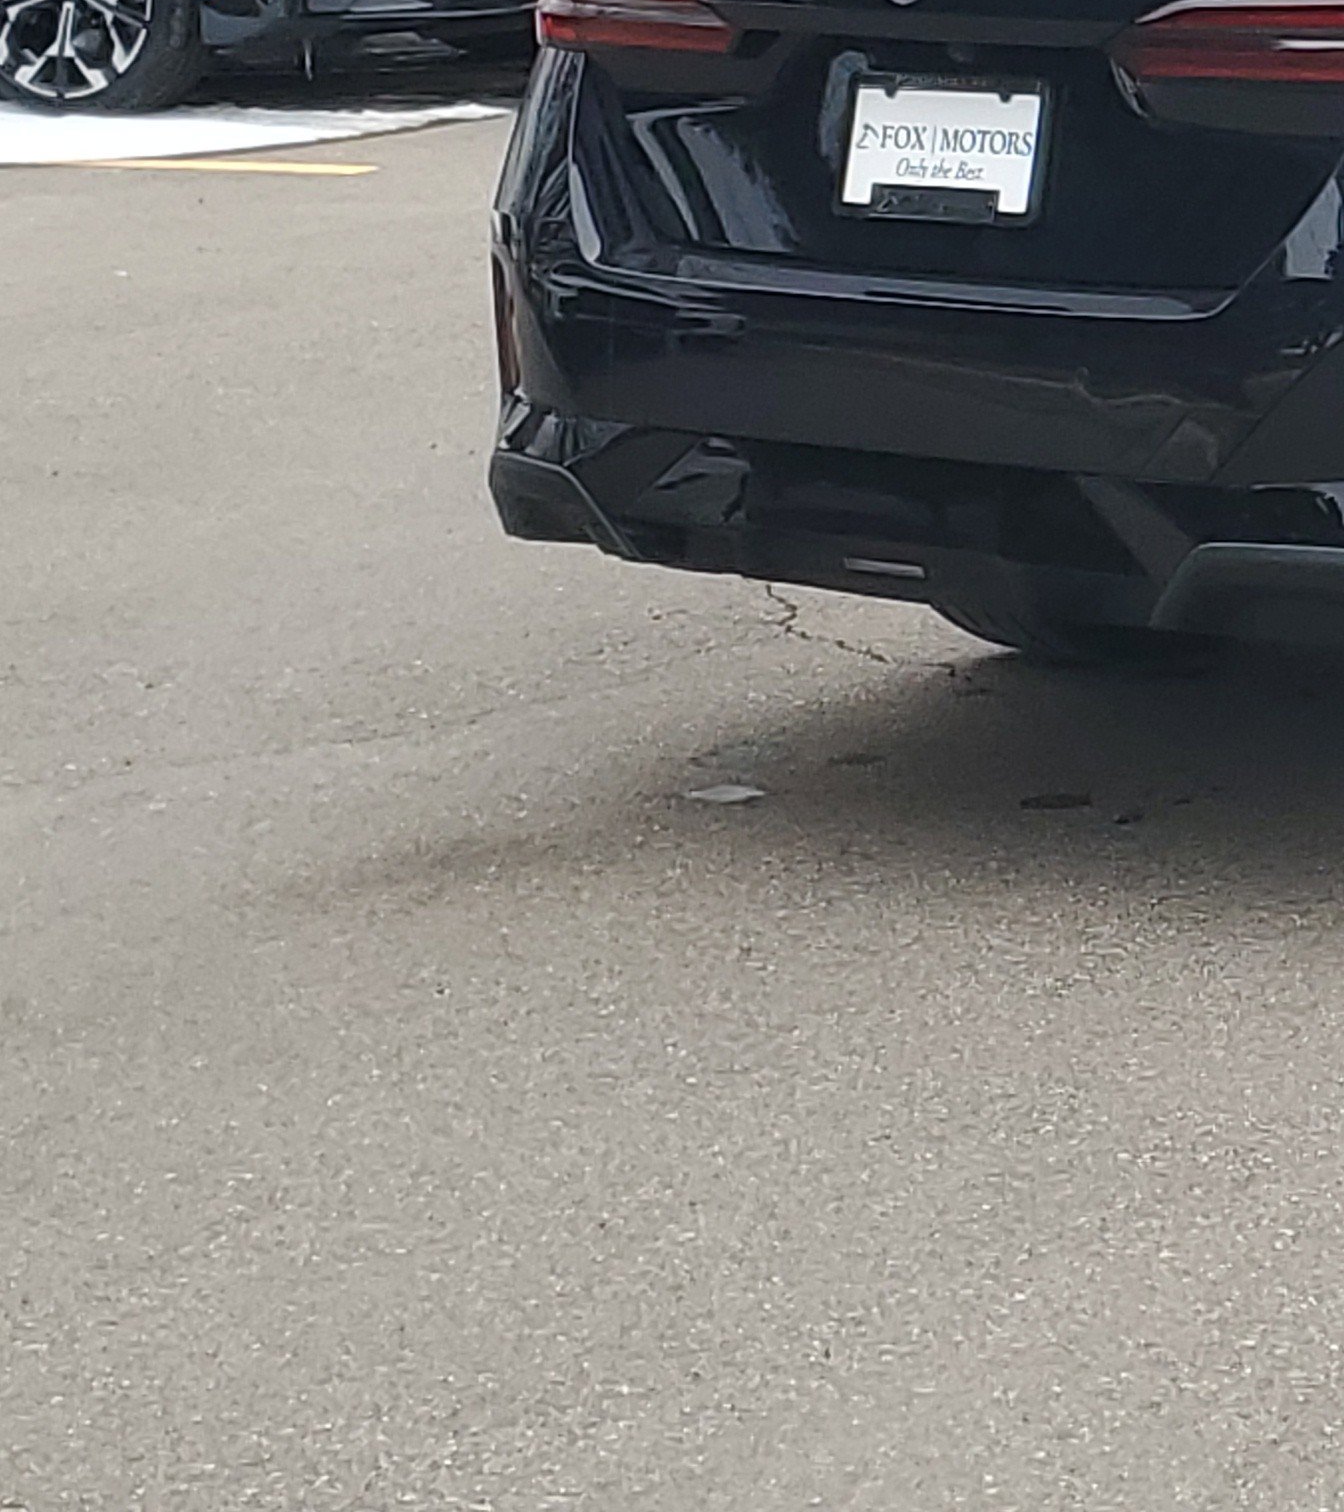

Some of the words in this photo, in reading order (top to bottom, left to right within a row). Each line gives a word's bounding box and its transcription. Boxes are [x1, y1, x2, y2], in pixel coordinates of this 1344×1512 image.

[880, 125, 927, 151] FOX
[940, 128, 1033, 156] MOTORS
[931, 157, 953, 178] the
